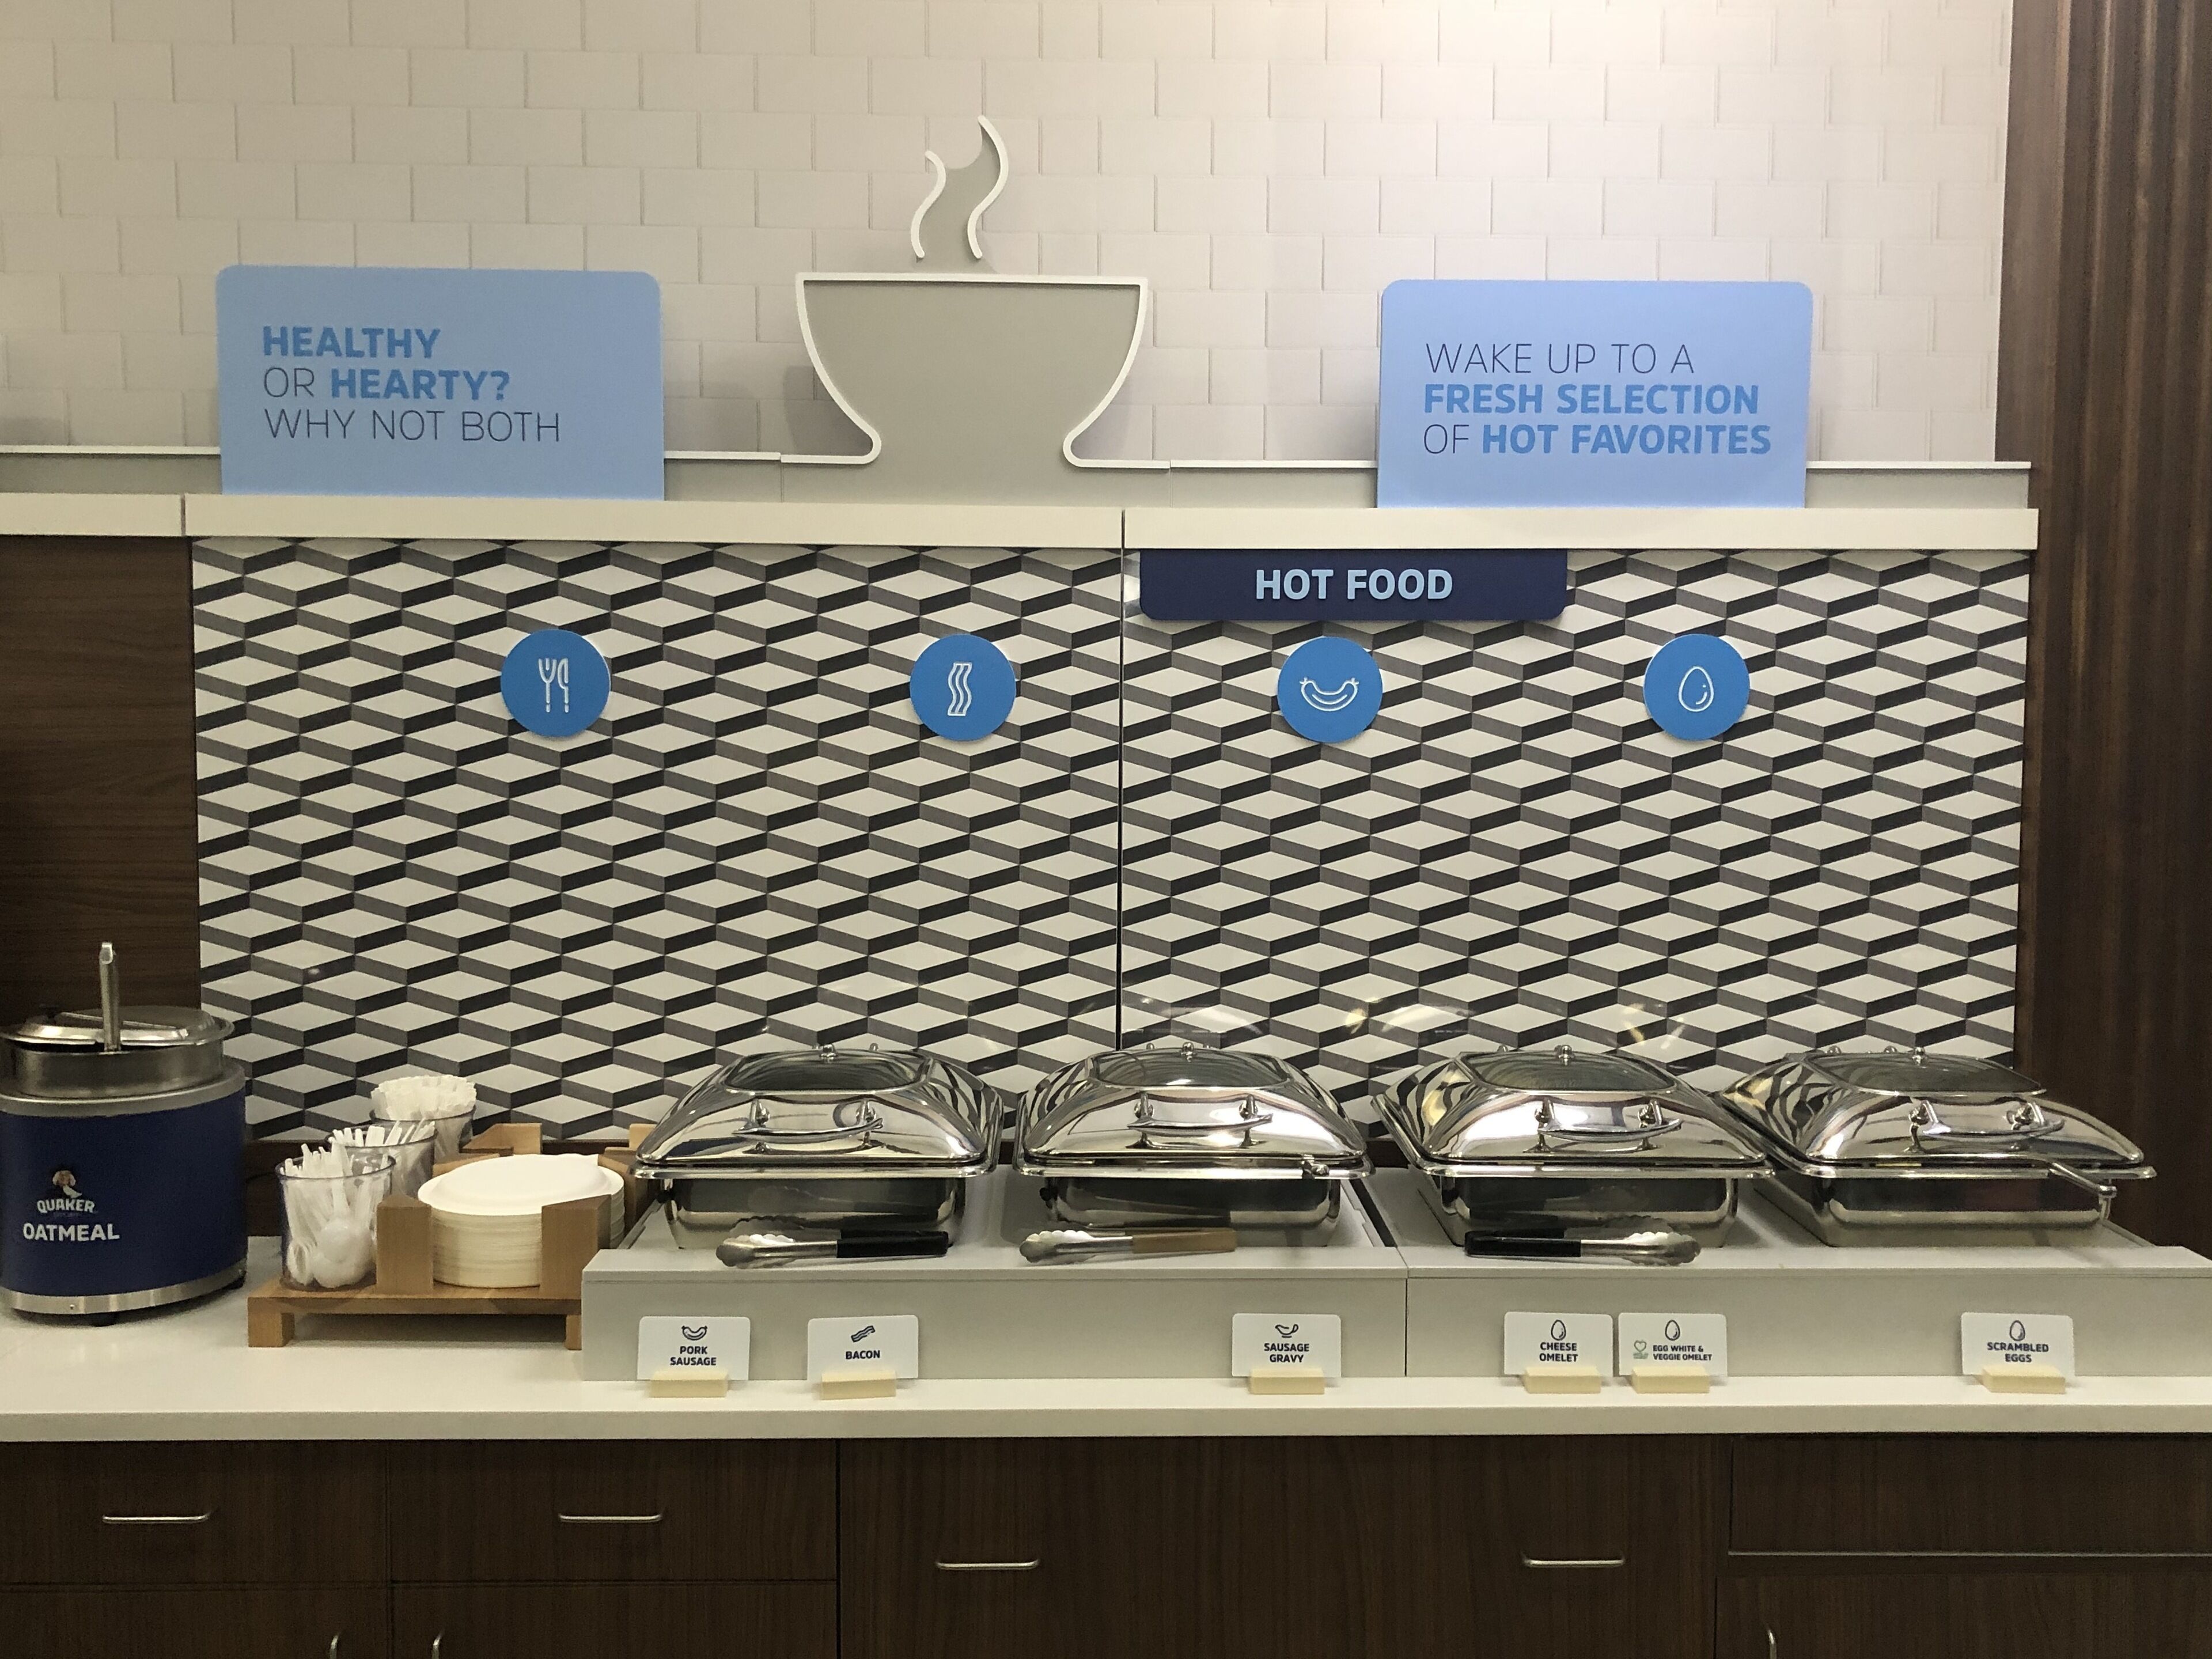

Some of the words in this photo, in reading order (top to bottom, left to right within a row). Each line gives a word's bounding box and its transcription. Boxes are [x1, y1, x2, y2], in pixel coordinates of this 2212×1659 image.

[263, 325, 441, 359] HEALTHY
[1426, 343, 1532, 373] WAKE
[1548, 343, 1596, 374] UP
[1611, 343, 1656, 374] TO
[1671, 344, 1694, 374] A
[263, 366, 315, 398] OR
[331, 368, 510, 402] HEARTY?
[1424, 383, 1543, 414] FRESH
[1556, 384, 1759, 415] SELECTION
[264, 408, 355, 439] WHY
[372, 410, 445, 441] NOT
[461, 411, 559, 442] BOTH
[1423, 424, 1469, 454] OF
[1483, 424, 1559, 454] HOT
[1571, 423, 1771, 454] FAVORITES
[1256, 569, 1334, 600] HOT
[1347, 569, 1453, 600] FOOD
[36, 1198, 95, 1214] QUAKER
[22, 1222, 120, 1241] OATMEAL
[680, 1346, 708, 1355] PORK
[1264, 1343, 1309, 1352] SAUSAGE
[1540, 1342, 1577, 1351] CHEESE
[1987, 1342, 2049, 1353] SCRAMBLED
[845, 1350, 880, 1360] BACON
[1269, 1354, 1304, 1363] GRAVY
[1539, 1353, 1578, 1362] OMELET
[1682, 1353, 1713, 1361] OMELET
[2005, 1353, 2032, 1363] EGGS
[670, 1357, 717, 1366] SAUSAGE
